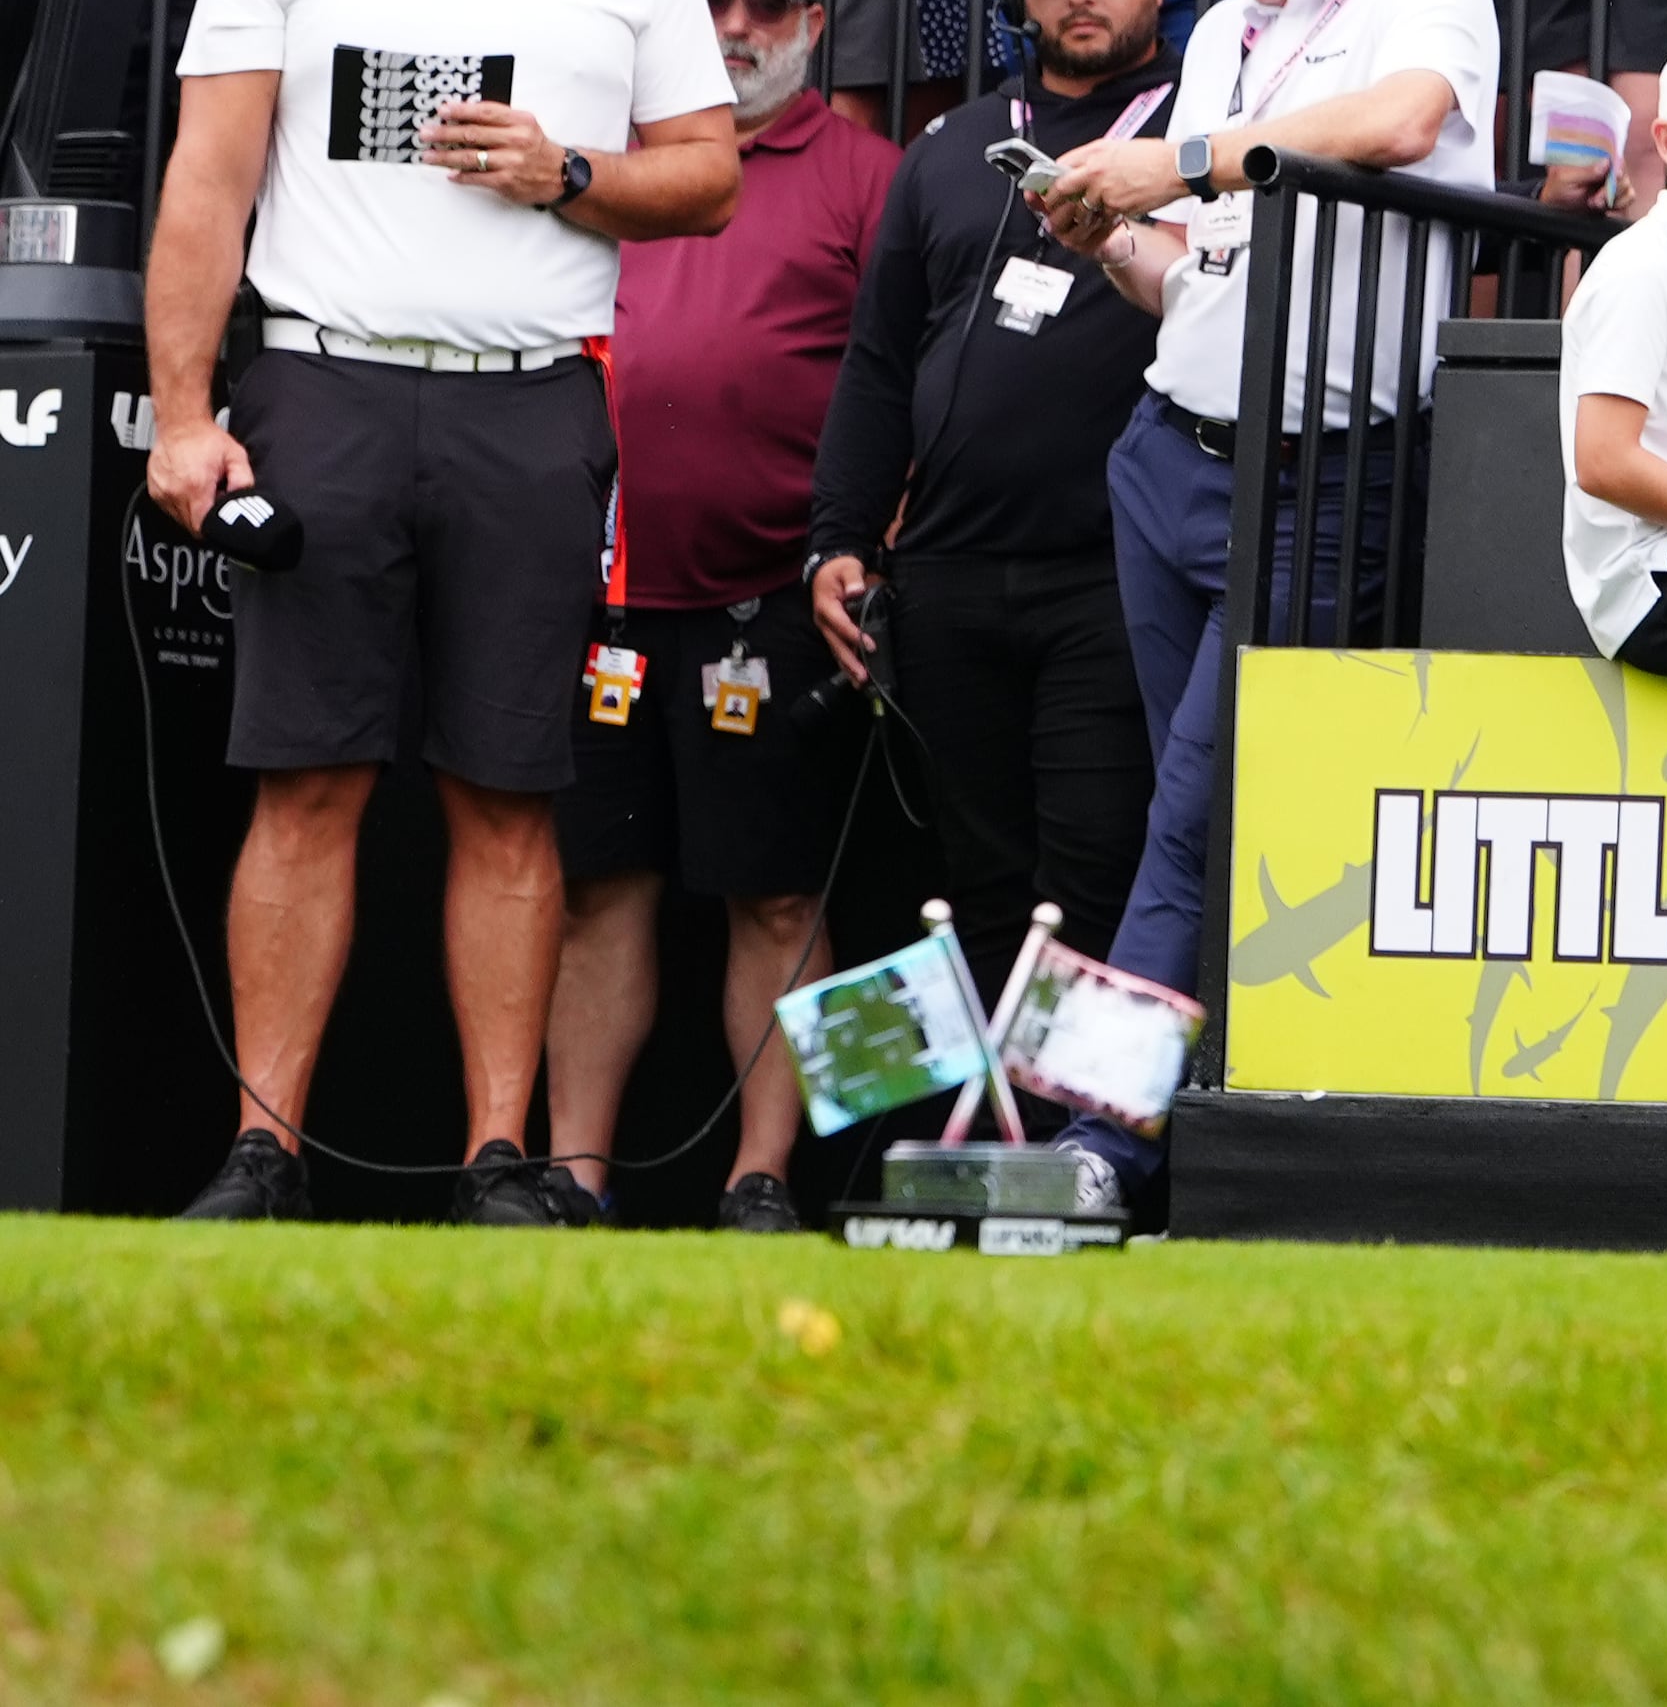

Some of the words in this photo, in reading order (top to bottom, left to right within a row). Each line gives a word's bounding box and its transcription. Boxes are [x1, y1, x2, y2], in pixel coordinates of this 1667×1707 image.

[361, 68, 417, 91] LIV
[413, 71, 483, 94] GOLF
[360, 87, 417, 110] LIV
[125, 514, 234, 620] Aspre
[153, 626, 225, 646] LONDON
